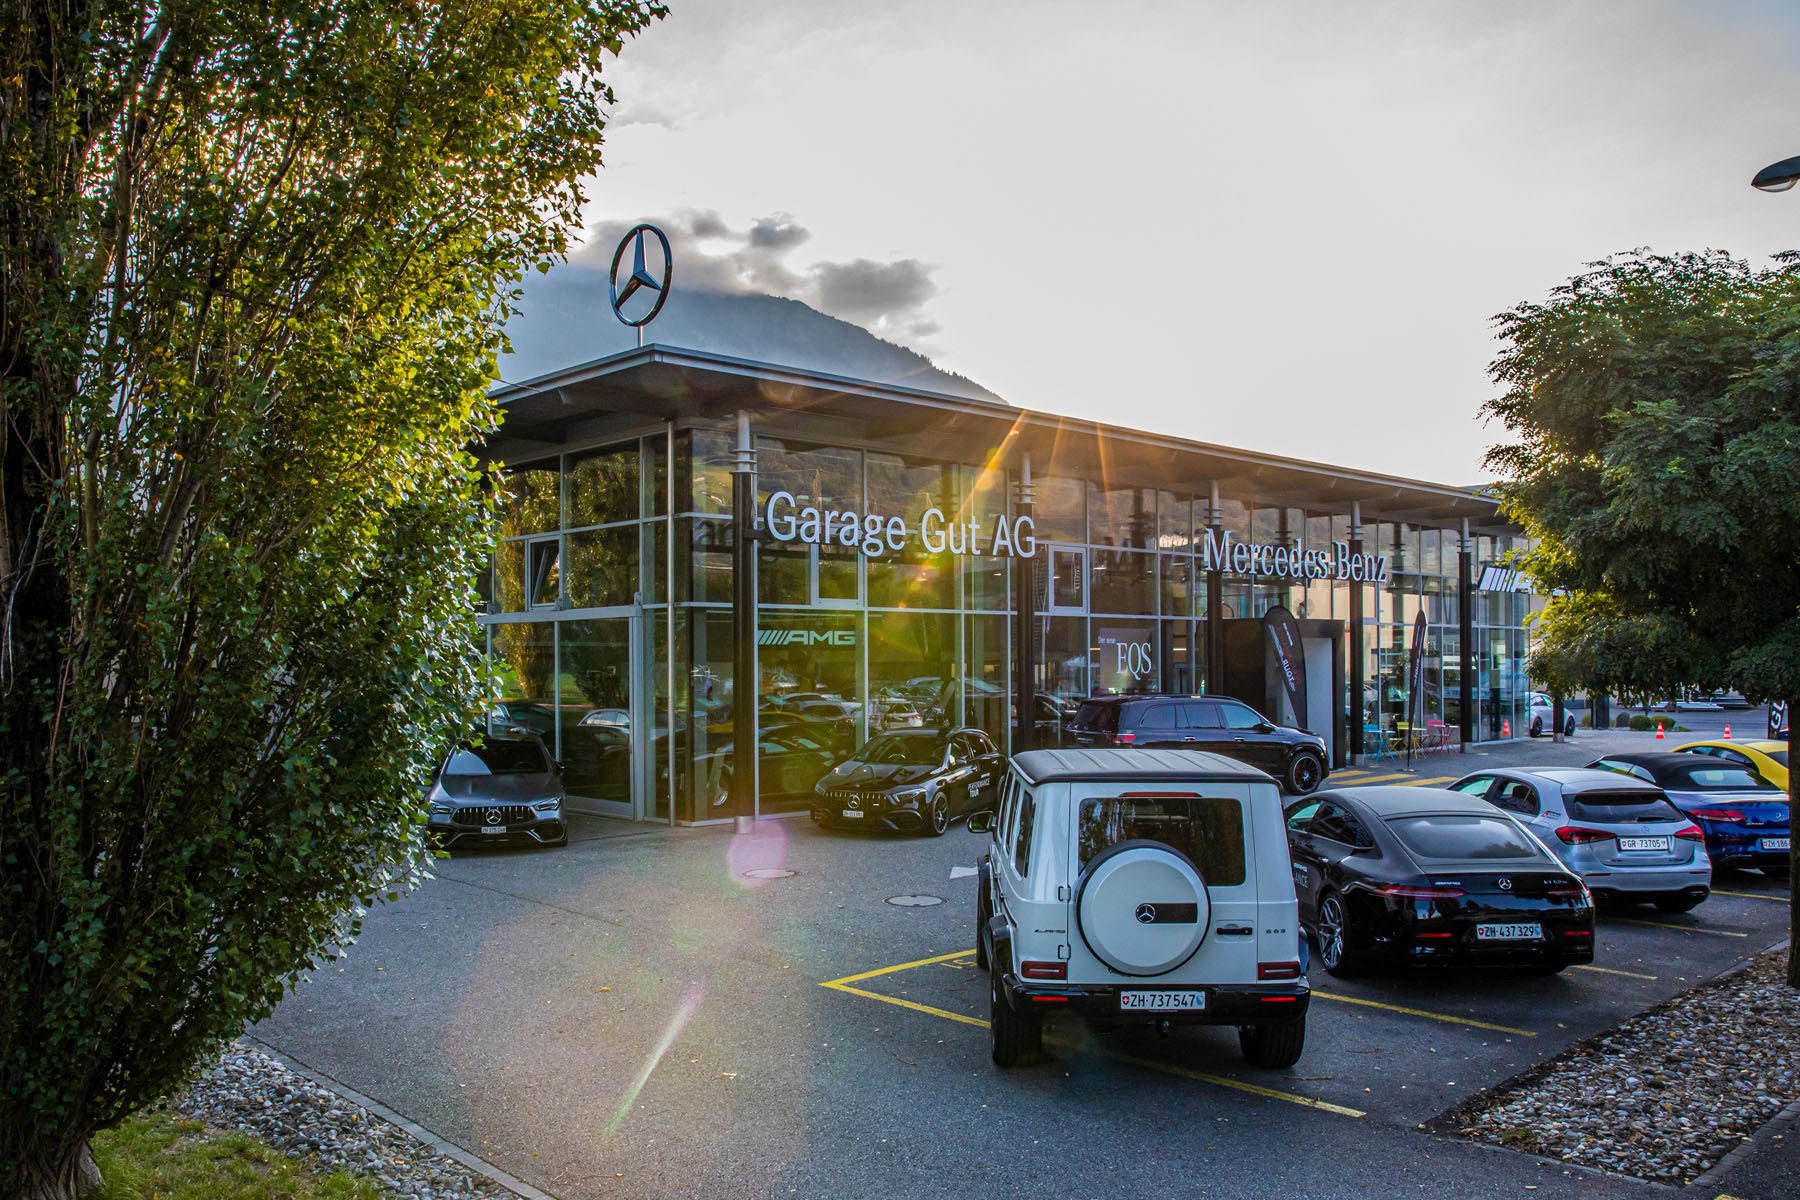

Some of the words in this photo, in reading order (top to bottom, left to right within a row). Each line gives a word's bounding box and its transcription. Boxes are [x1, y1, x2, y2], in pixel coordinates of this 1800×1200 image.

[765, 491, 906, 557] Garage
[921, 508, 981, 555] Gut
[992, 515, 1035, 558] AG
[1205, 528, 1387, 582] Mercedes-Benz
[1116, 642, 1152, 680] EQS
